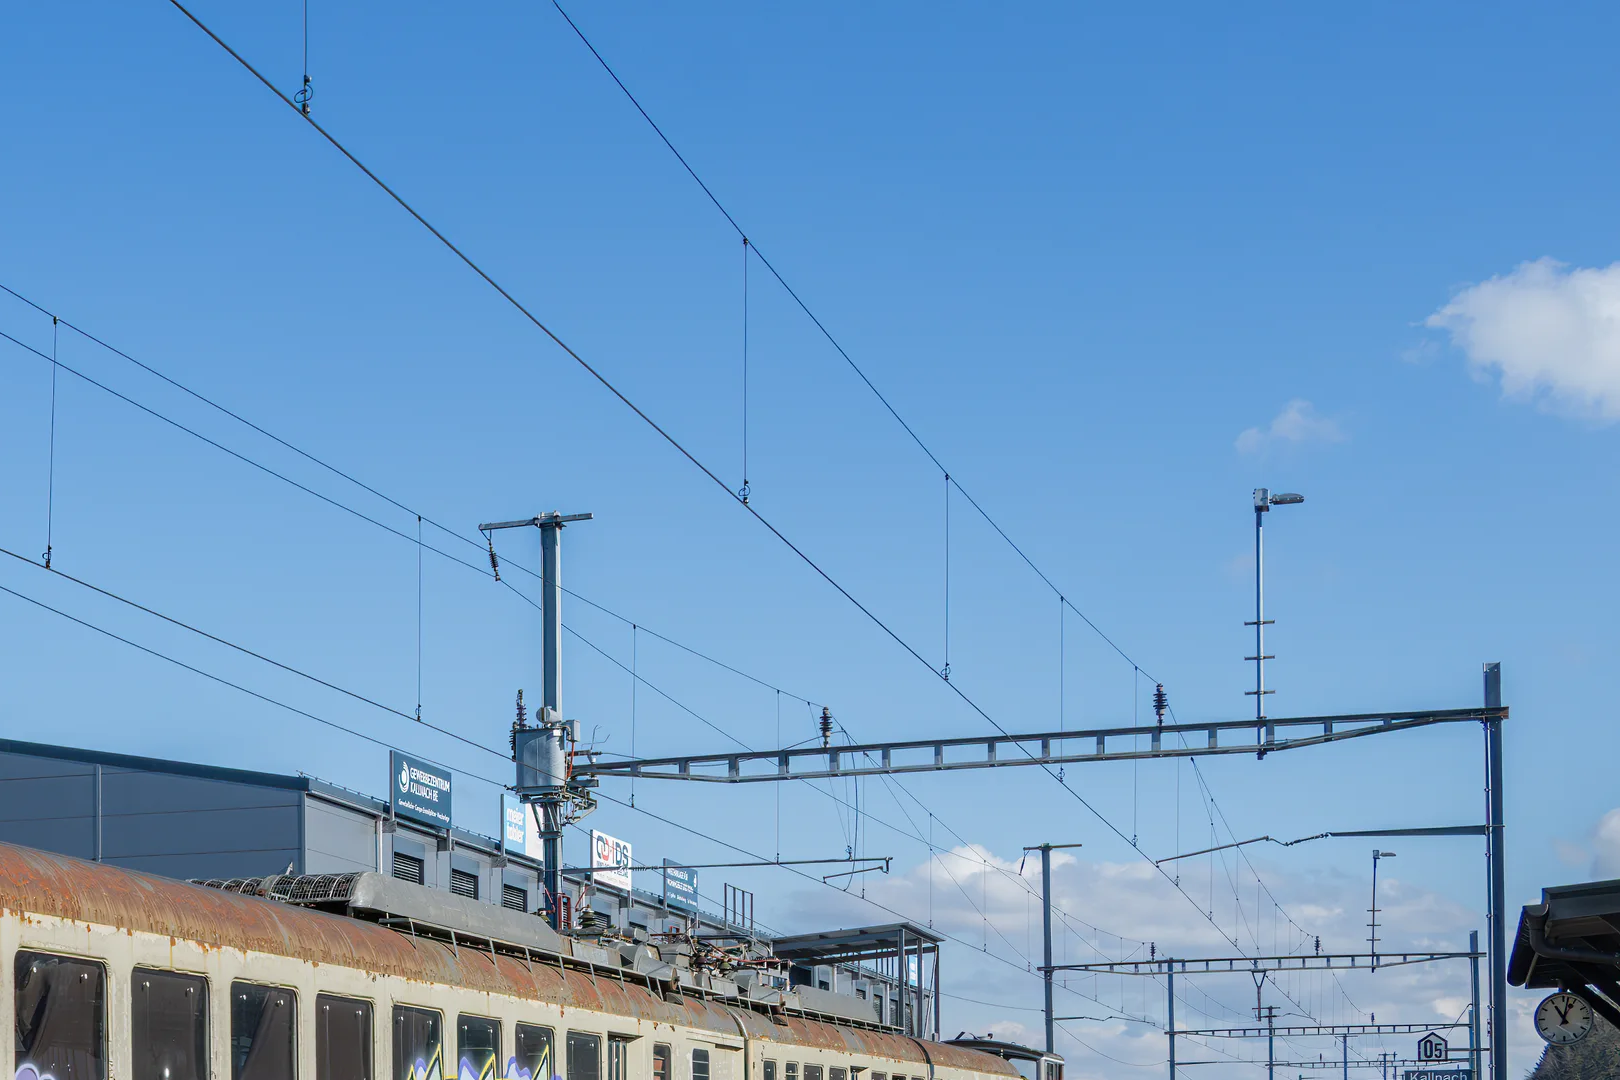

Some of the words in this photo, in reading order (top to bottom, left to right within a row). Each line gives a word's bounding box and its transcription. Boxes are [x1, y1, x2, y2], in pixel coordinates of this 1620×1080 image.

[410, 767, 450, 792] GEWERBEZENTRUM
[410, 781, 433, 800] KALLNACH
[433, 790, 439, 802] BE
[1423, 1039, 1442, 1058] 05
